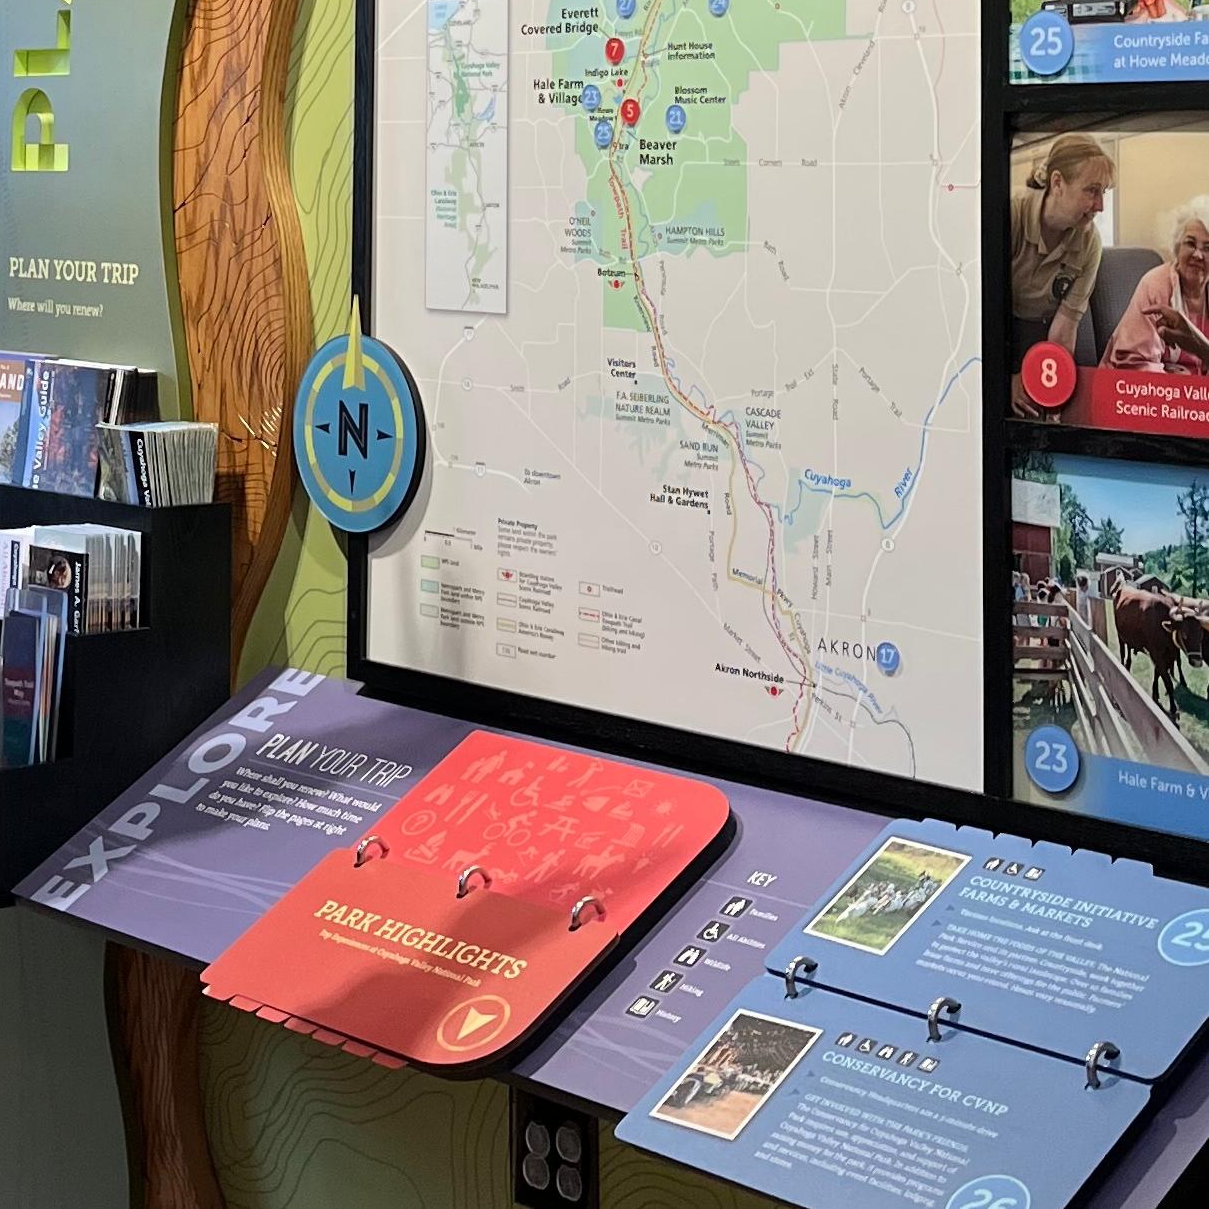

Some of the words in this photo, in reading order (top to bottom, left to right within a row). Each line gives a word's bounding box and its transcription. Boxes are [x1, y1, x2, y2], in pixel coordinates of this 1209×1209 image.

[561, 7, 599, 19] Everett
[521, 23, 563, 35] Covered
[565, 22, 599, 35] Bridge
[668, 43, 686, 51] Hunt
[689, 42, 712, 50] House
[1030, 27, 1062, 56] 25
[1114, 33, 1190, 49] Countryside
[1195, 32, 1209, 45] Fa
[1114, 56, 1126, 68] at
[1130, 55, 1166, 68] Howe
[534, 79, 556, 89] Hale
[558, 79, 584, 89] Farm
[675, 86, 708, 94] Blossom
[538, 95, 546, 104] &
[675, 96, 696, 104] Music
[698, 96, 726, 104] Center
[639, 140, 677, 150] Beaver
[639, 154, 673, 165] Marsh
[665, 227, 703, 236] HAMPTON
[705, 227, 725, 236] HILLS
[9, 257, 50, 279] PLAN
[54, 259, 97, 283] YOUR
[101, 262, 139, 285] TRIP
[7, 297, 35, 312] Where
[37, 298, 54, 314] will
[55, 304, 71, 317] you
[73, 304, 104, 317] renew?
[607, 358, 636, 368] Visitors
[611, 369, 636, 379] Center
[1041, 358, 1057, 388] 8
[1116, 380, 1180, 400] Cuyahoga
[745, 407, 781, 419] CASCADE
[1116, 400, 1157, 417] Scenic
[32, 425, 45, 471] Valley
[39, 371, 50, 416] Guide
[338, 400, 369, 459] N
[745, 420, 774, 430] VALLEY
[138, 439, 149, 488] Cuyahoga
[804, 468, 852, 490] Cuyahoga
[894, 467, 913, 499] River
[650, 493, 665, 504] Hall
[668, 496, 675, 505] &
[677, 498, 709, 510] Gardens
[74, 561, 82, 594] James
[74, 597, 81, 607] A.
[818, 637, 876, 661] AKRON
[880, 652, 894, 664] 17
[715, 662, 740, 676] Akron
[742, 668, 784, 683] Northside
[256, 733, 319, 766] PLAN
[310, 745, 368, 779] YOUR
[360, 758, 412, 787] TRIP
[1035, 741, 1068, 773] 23
[31, 667, 327, 912] EXPLORE
[236, 766, 262, 782] Where
[261, 774, 284, 789] shall
[281, 781, 298, 791] you
[328, 791, 354, 803] What
[352, 798, 382, 813] would
[1119, 771, 1147, 789] Hale
[1151, 777, 1183, 795] Farm
[1187, 784, 1195, 797] &
[219, 779, 239, 789] you
[238, 782, 254, 793] like
[253, 786, 263, 796] to
[295, 799, 317, 811] How
[316, 803, 341, 818] much
[340, 811, 363, 824] time
[196, 803, 205, 811] to
[204, 806, 228, 818] make
[227, 812, 247, 826] your
[209, 790, 220, 799] do
[219, 794, 237, 807] you
[257, 803, 276, 817] Flip
[275, 808, 289, 820] the
[286, 812, 314, 827] pages
[312, 820, 325, 829] at
[323, 823, 347, 836] right
[747, 871, 777, 887] KEY
[958, 888, 1007, 909] FARMS
[1008, 898, 1020, 909] &
[1022, 901, 1094, 929] MARKETS
[969, 875, 1075, 910] COUNTRYSIDE
[1073, 900, 1159, 930] INITIATIVE
[750, 908, 778, 921] Families
[314, 900, 381, 933] PARK
[374, 919, 528, 979] HIGHLIGHTS
[727, 933, 739, 941] All
[738, 937, 766, 949] Abilities
[680, 984, 704, 997] Hiking
[655, 1009, 682, 1023] History
[822, 1050, 934, 1093] CONSERVANCY
[929, 1085, 965, 1104] FOR
[962, 1094, 1010, 1118] CVNP
